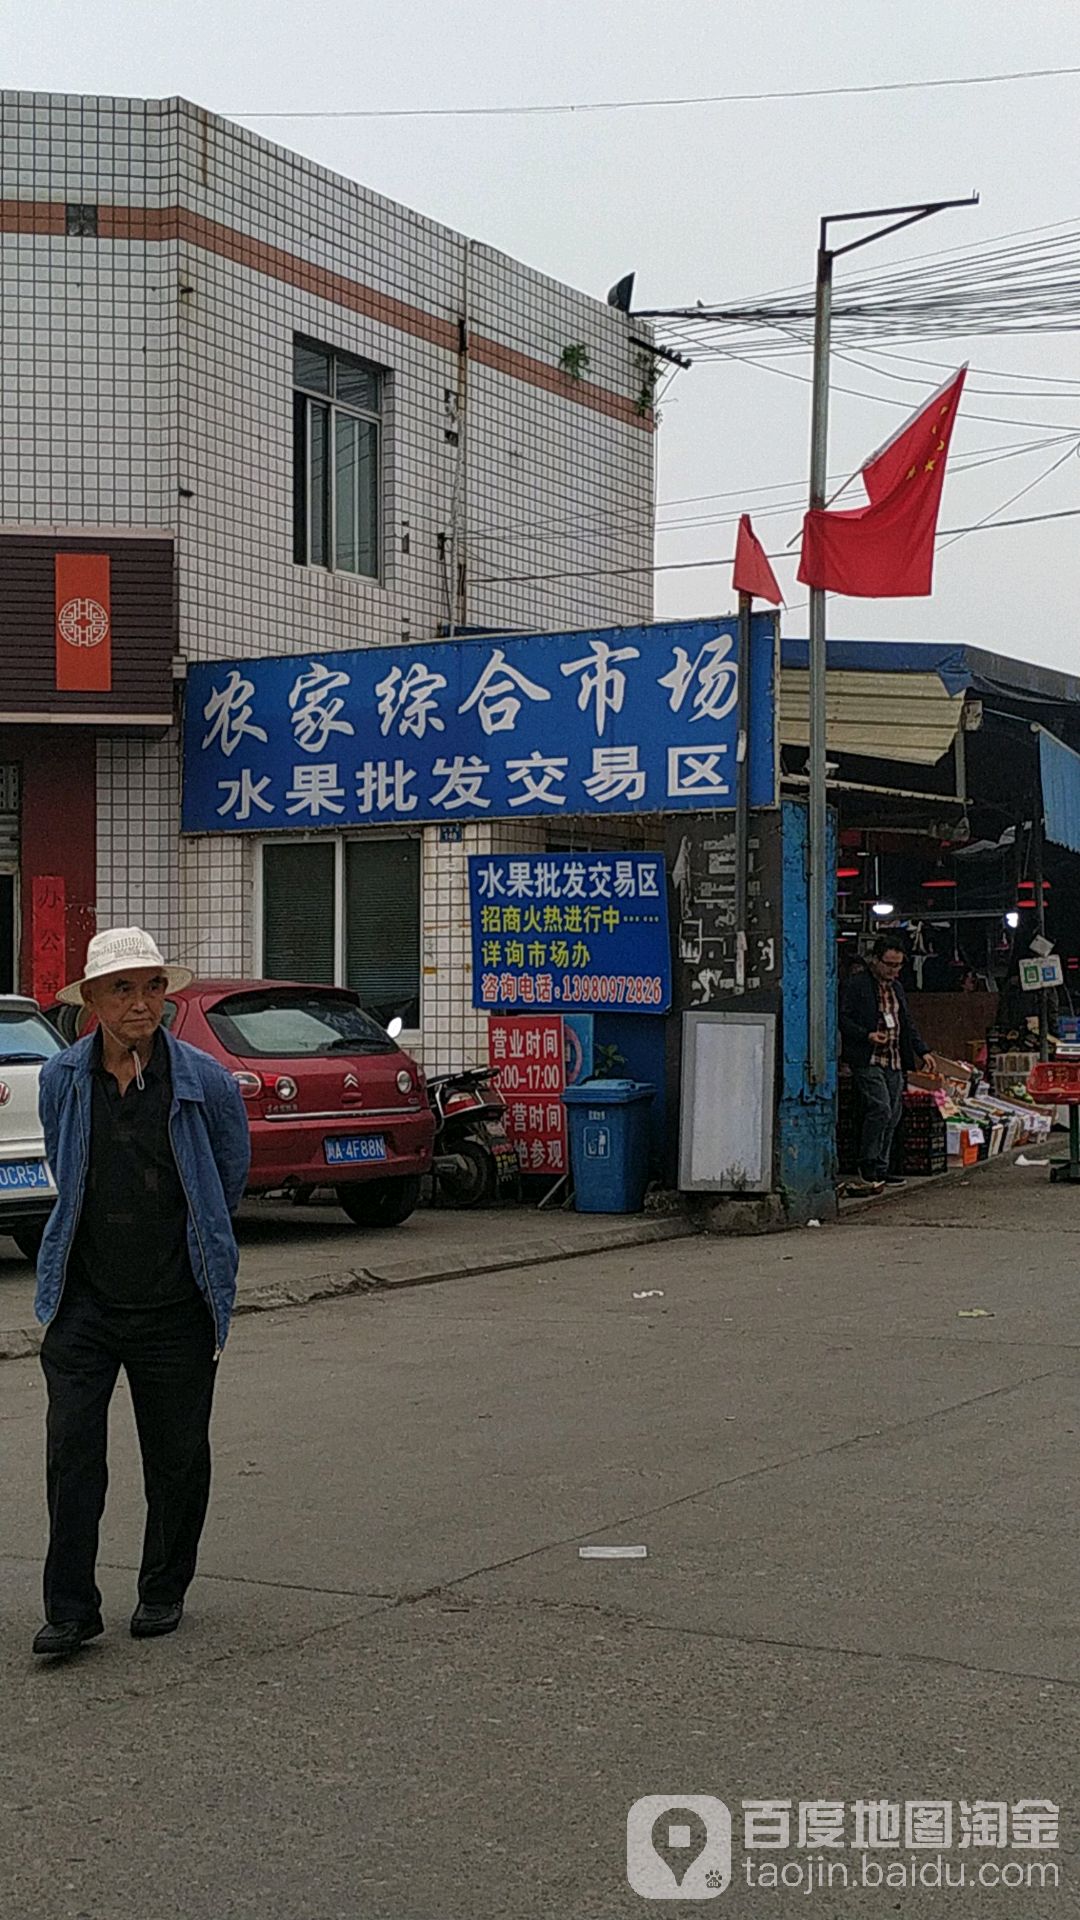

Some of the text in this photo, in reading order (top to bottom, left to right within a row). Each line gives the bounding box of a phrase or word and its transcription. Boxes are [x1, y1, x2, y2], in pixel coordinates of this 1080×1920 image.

[201, 633, 740, 757] 农家综合市场
[215, 743, 731, 821] 水果批发交易区
[477, 860, 660, 899] 水果批发交易区
[39, 884, 61, 995] 办公室
[481, 939, 592, 969] 详询市场办
[492, 1027, 559, 1060] 营业时间
[486, 1064, 561, 1089] 5:00-17:00
